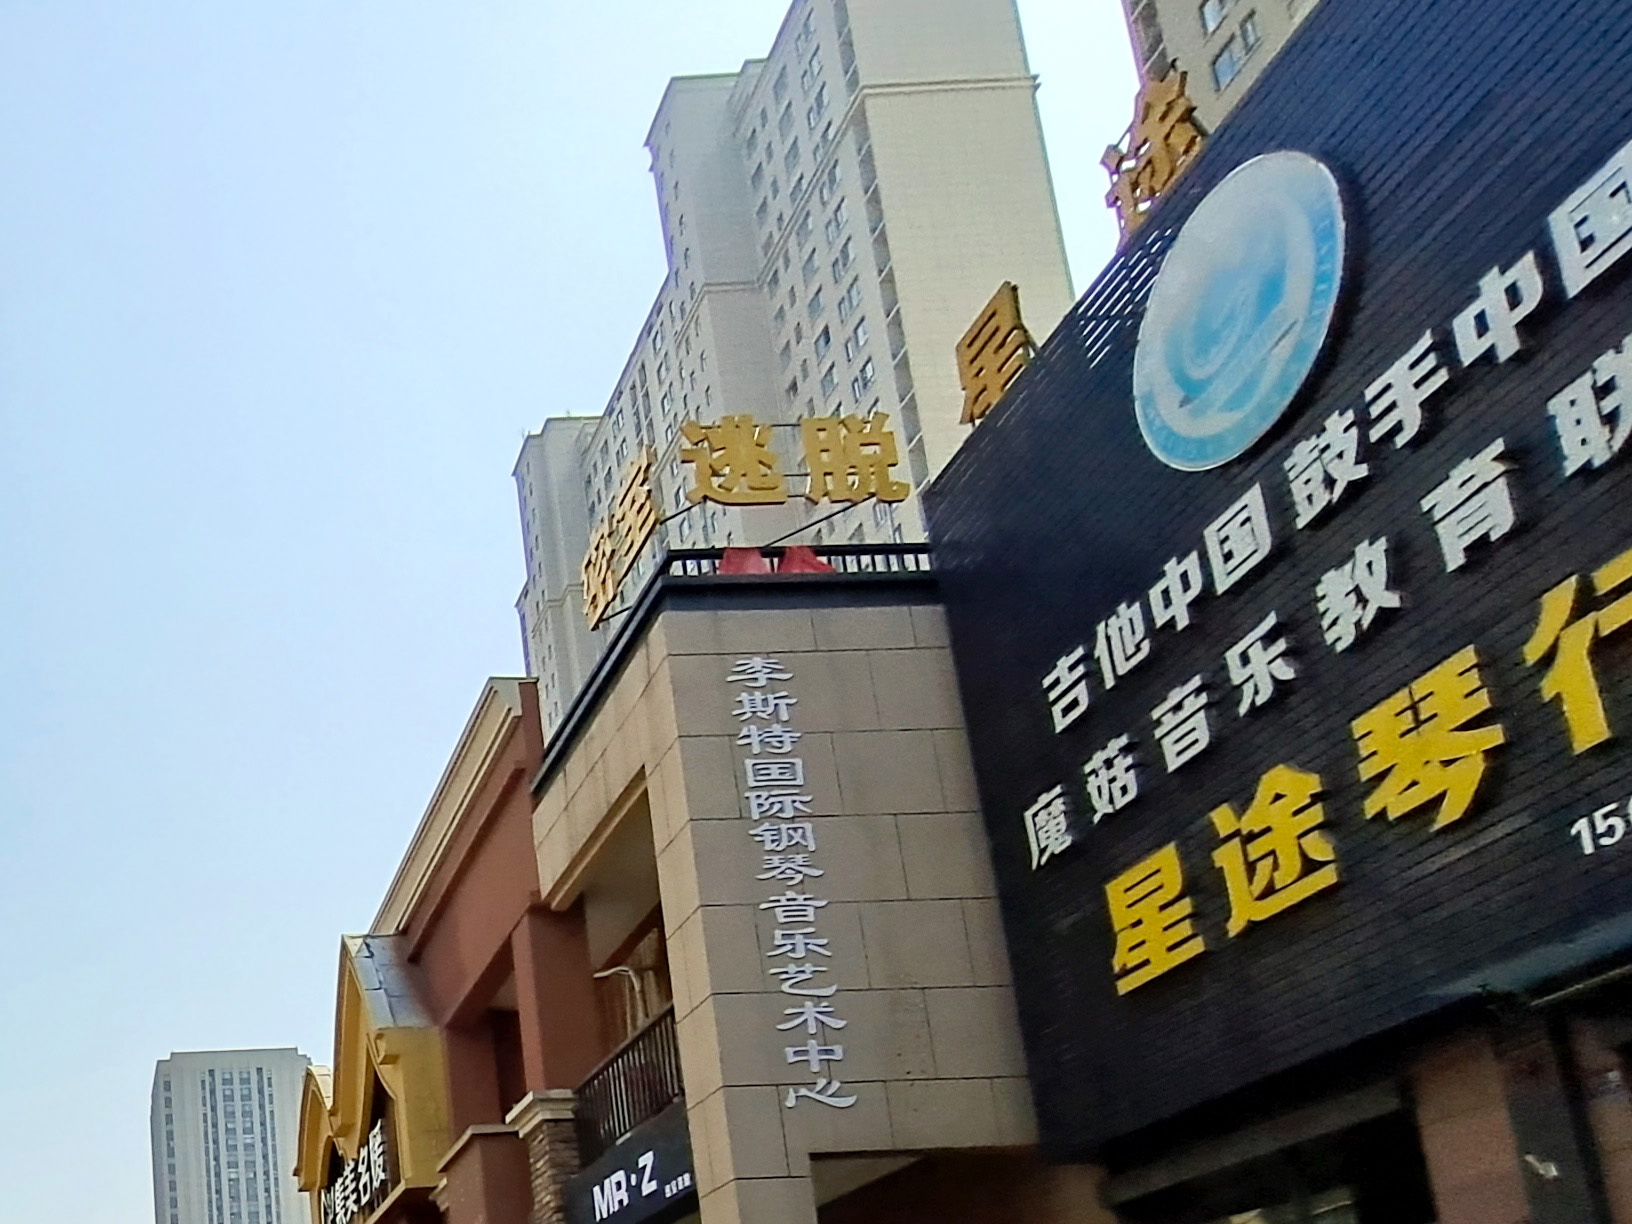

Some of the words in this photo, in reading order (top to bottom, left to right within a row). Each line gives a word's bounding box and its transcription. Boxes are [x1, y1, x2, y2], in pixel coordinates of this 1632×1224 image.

[679, 411, 911, 506] 逃脱
[1040, 482, 1274, 735] 吉他中国
[726, 656, 858, 1110] 李斯特国际钢琴音乐艺术中心
[1570, 797, 1632, 856] 15
